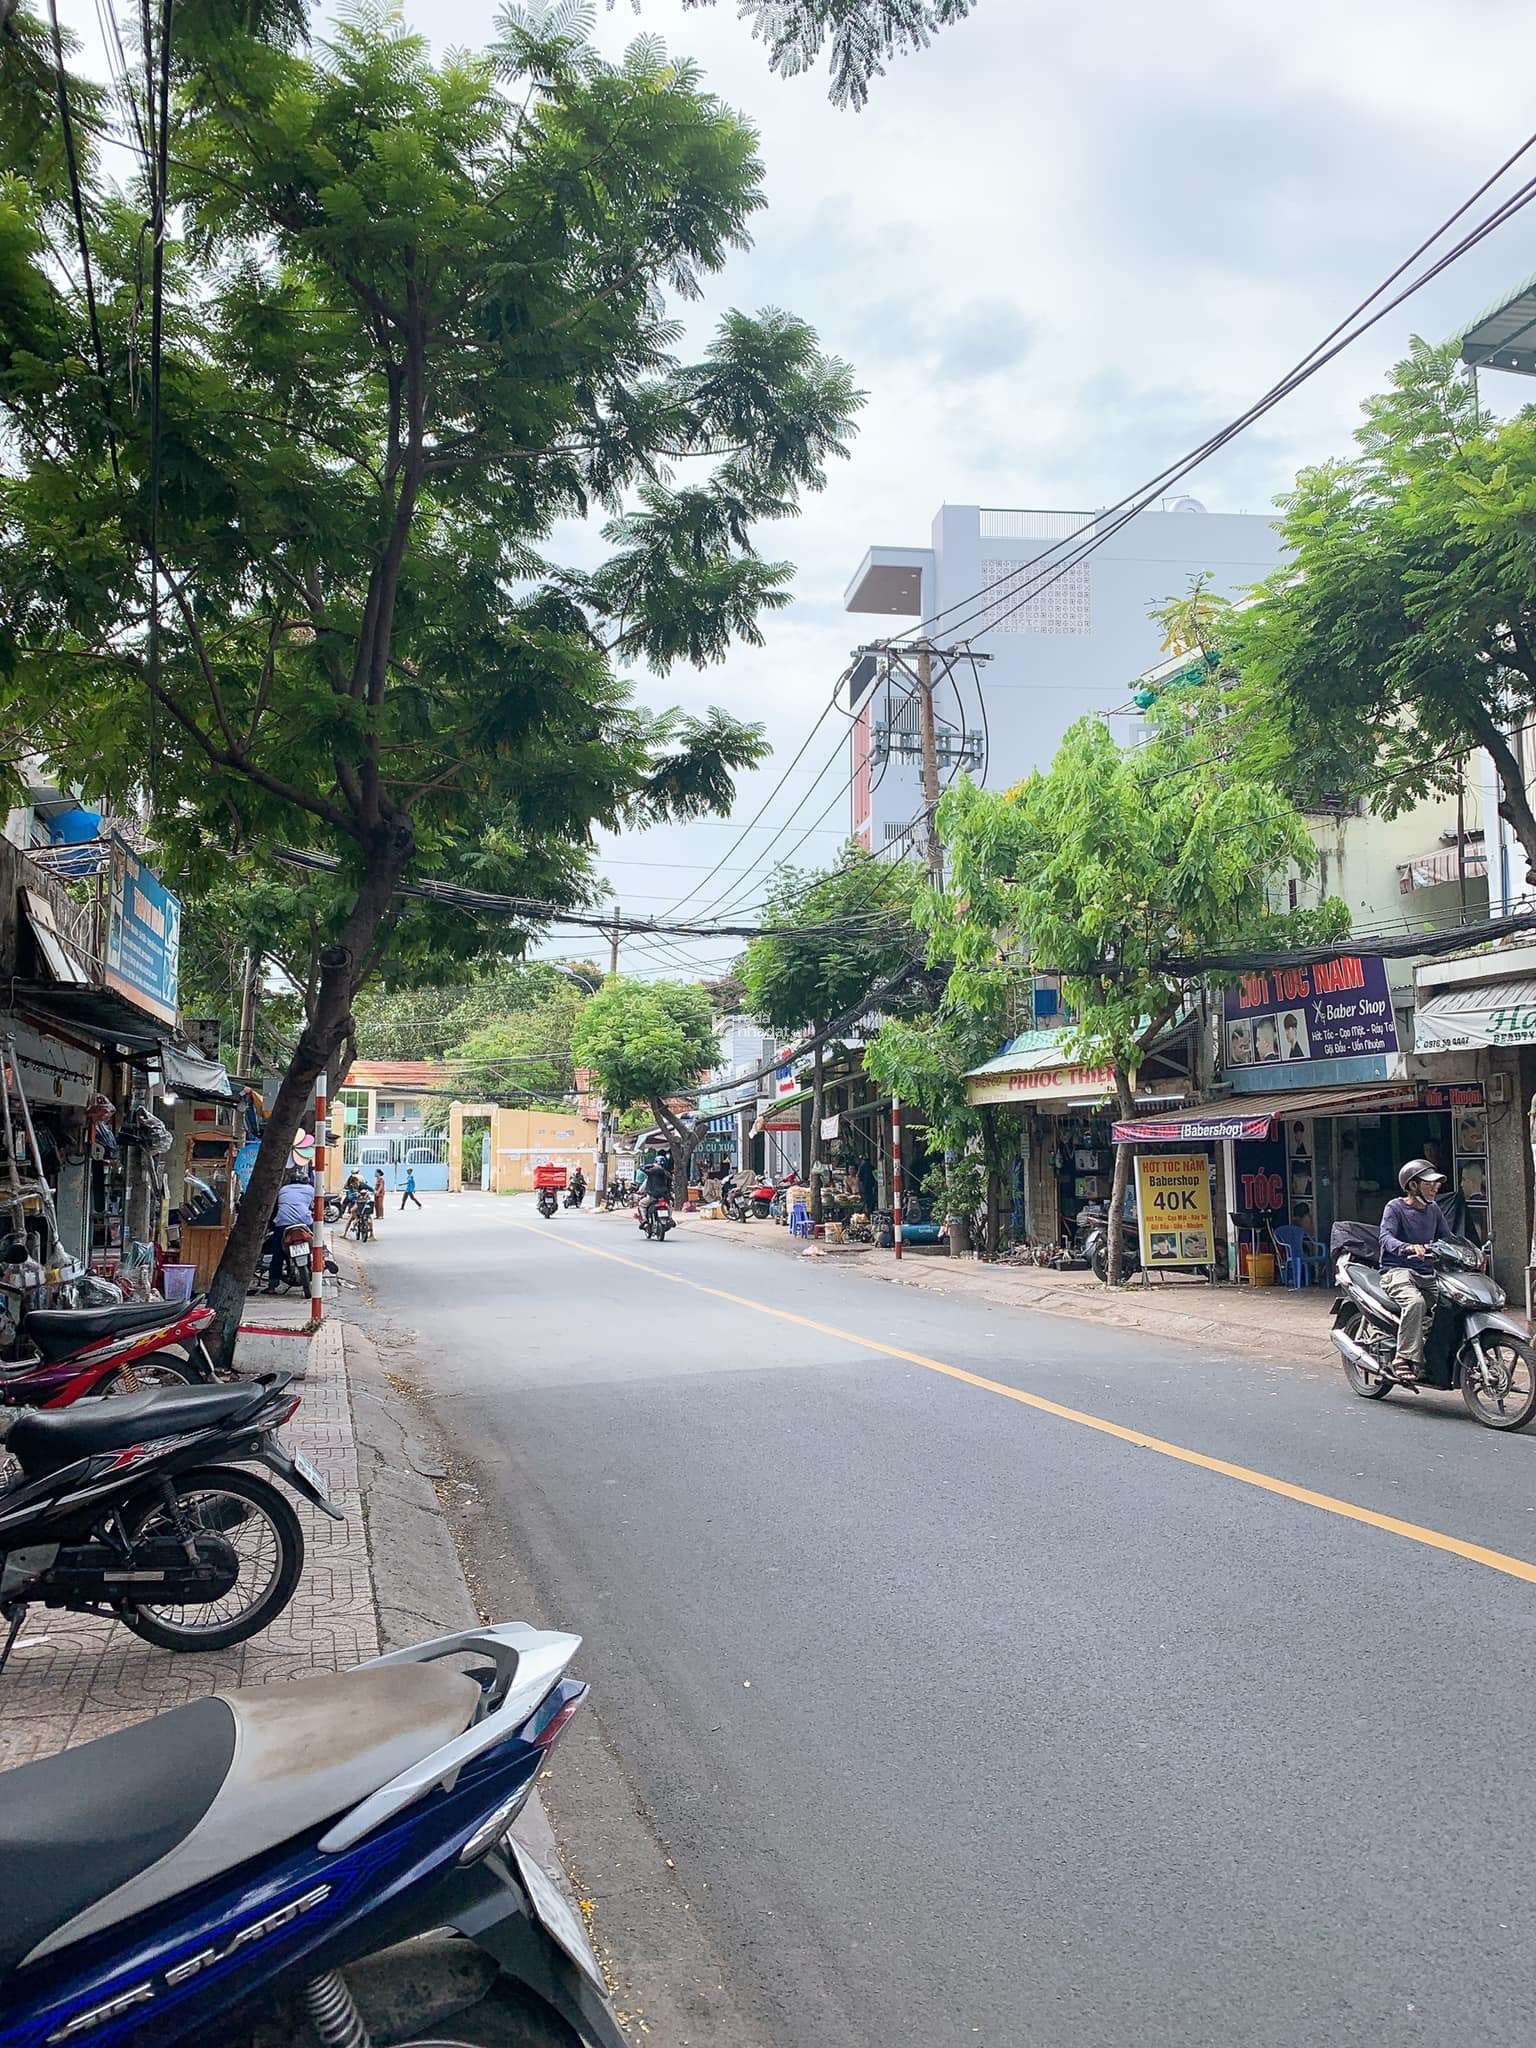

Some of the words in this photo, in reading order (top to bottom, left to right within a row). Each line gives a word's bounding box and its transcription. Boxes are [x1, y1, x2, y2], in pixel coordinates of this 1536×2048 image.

[1312, 957, 1365, 994] NAM
[1326, 1003, 1357, 1020] Baber
[1358, 999, 1386, 1017] Shop
[1149, 1175, 1200, 1187] Babershop
[1241, 1167, 1283, 1210] TÓC
[1154, 1191, 1198, 1210] 40K
[165, 1884, 332, 1987] BLADE
